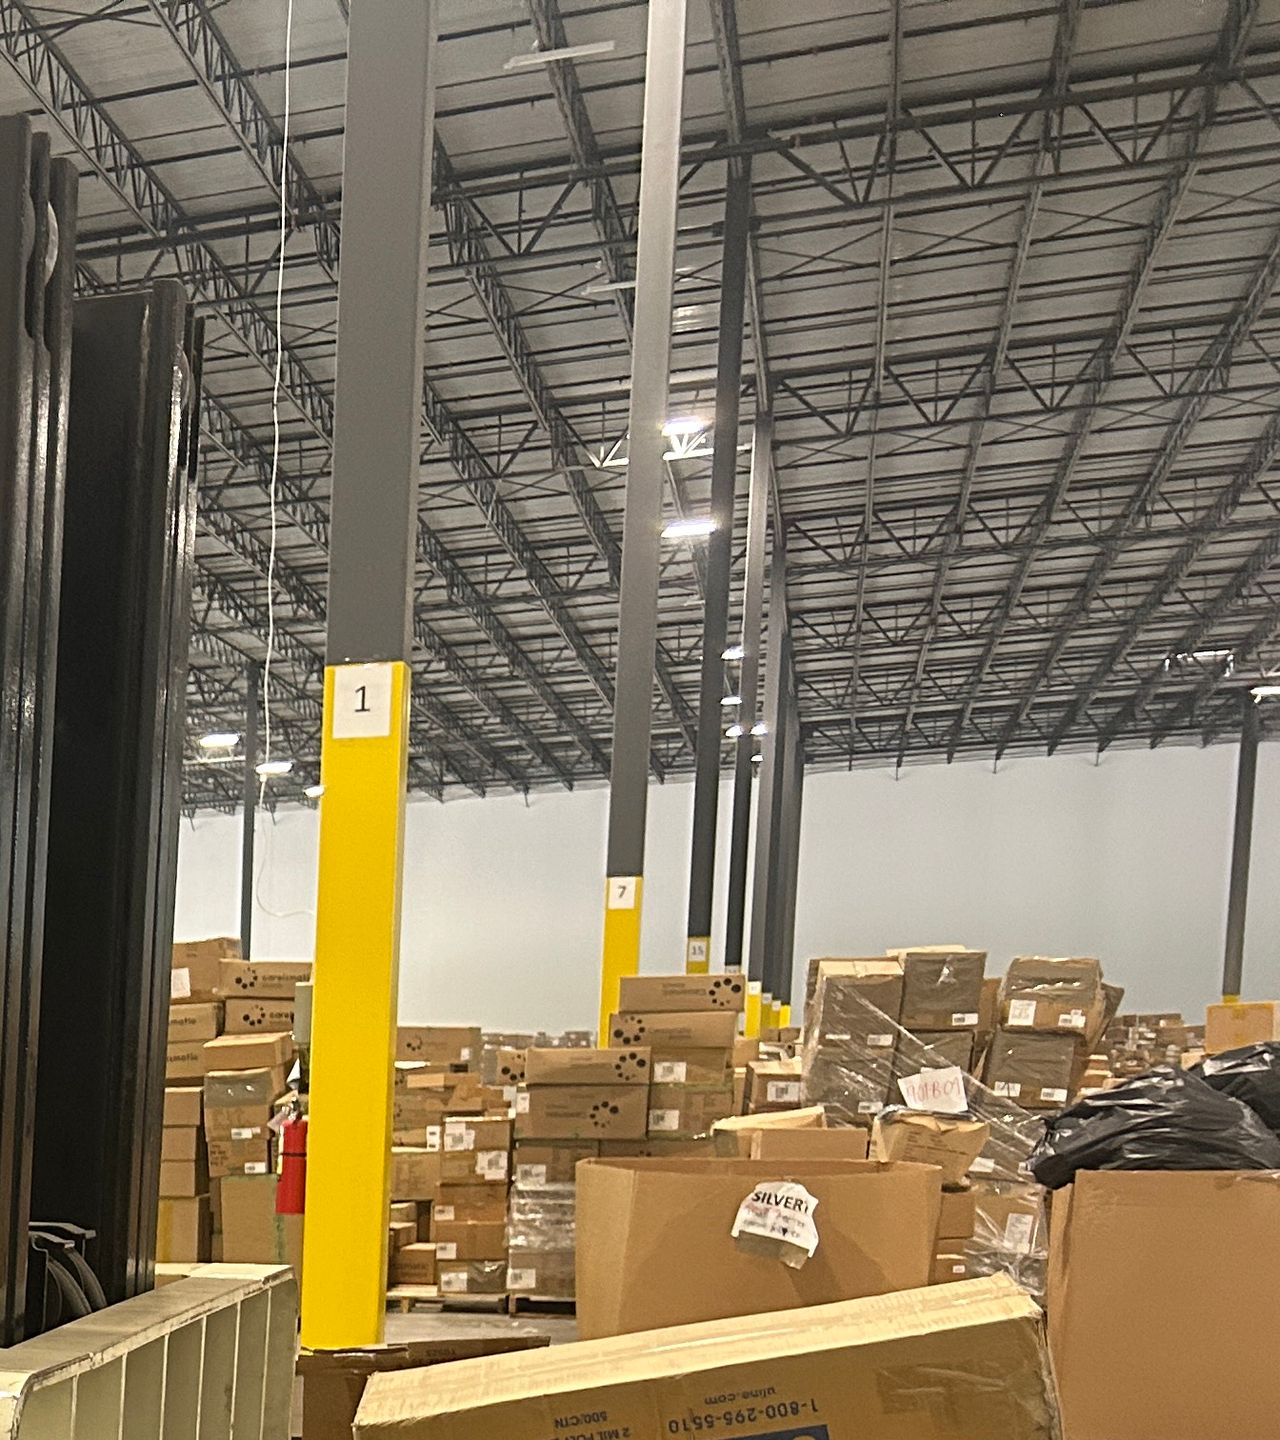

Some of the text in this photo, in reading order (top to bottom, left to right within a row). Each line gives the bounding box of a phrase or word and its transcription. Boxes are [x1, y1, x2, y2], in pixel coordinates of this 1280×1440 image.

[354, 685, 371, 713] 1
[617, 885, 627, 899] 7
[703, 1386, 777, 1406] uline.com
[668, 1398, 819, 1434] 1-800-295-5510
[621, 1427, 632, 1438] 2
